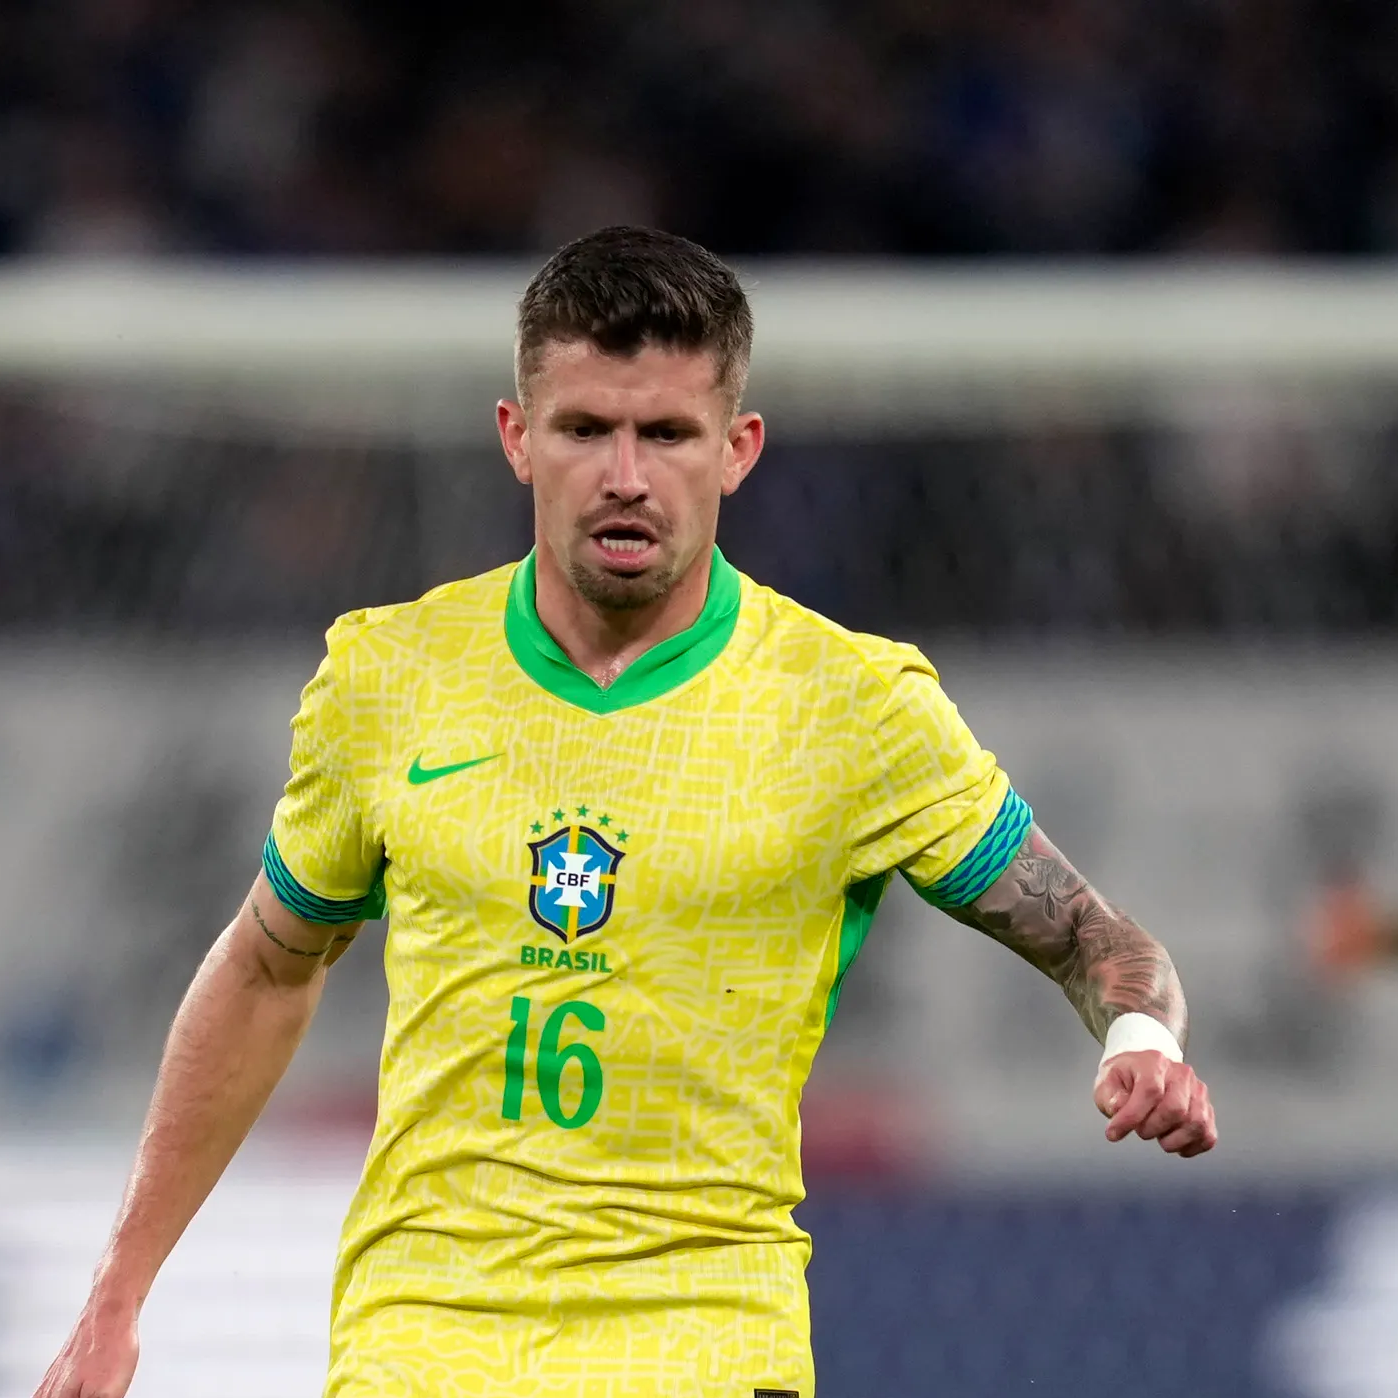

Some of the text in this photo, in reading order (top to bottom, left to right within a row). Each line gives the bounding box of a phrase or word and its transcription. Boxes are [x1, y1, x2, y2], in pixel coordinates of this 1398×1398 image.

[556, 872, 591, 887] CBF
[520, 945, 613, 973] BRASIL
[501, 996, 606, 1130] 16
